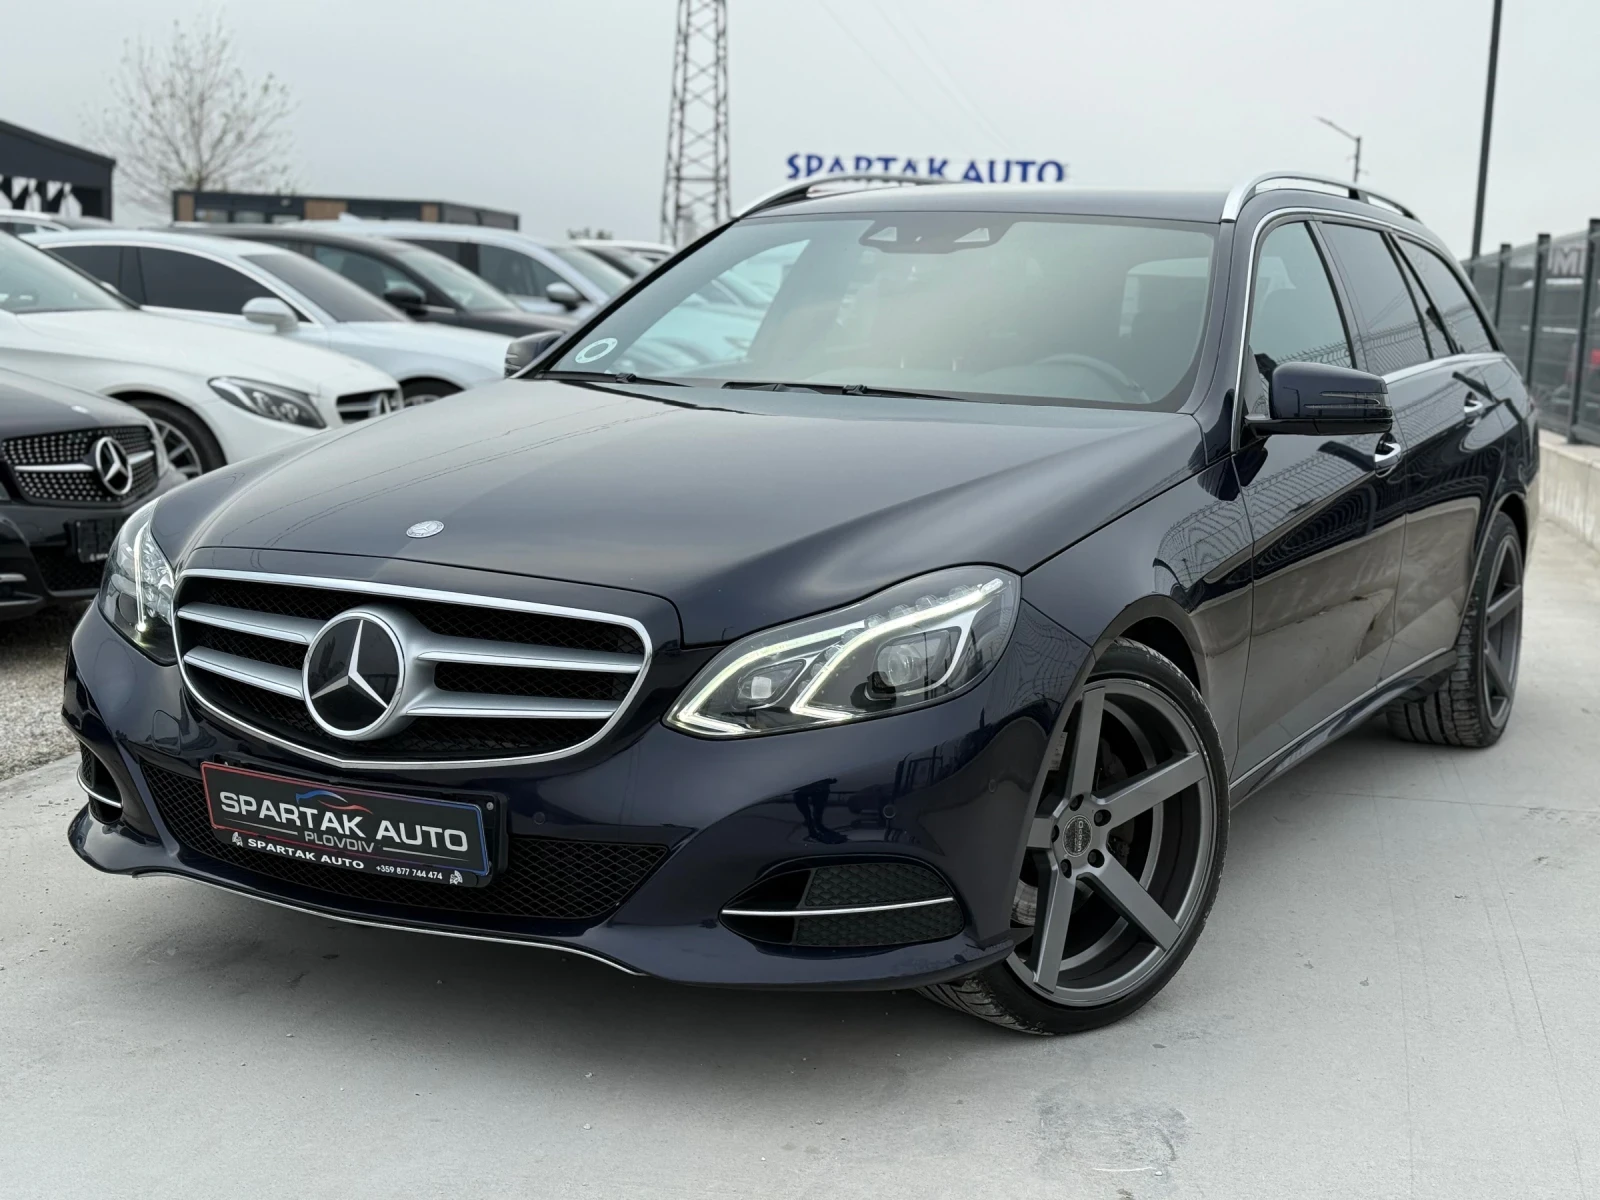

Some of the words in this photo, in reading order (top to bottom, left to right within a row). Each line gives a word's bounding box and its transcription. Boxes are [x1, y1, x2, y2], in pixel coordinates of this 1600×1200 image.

[787, 154, 949, 179] SPARTAK
[963, 160, 1066, 183] AUTO
[219, 791, 367, 839] SPARTAK
[375, 819, 468, 852] AUTO
[247, 838, 317, 861] SPARTAK
[320, 855, 365, 869] AUTO
[304, 830, 375, 853] PLOVDIV
[375, 864, 395, 873] +359
[396, 867, 410, 876] 877
[411, 868, 427, 877] 744
[427, 871, 443, 880] 474
